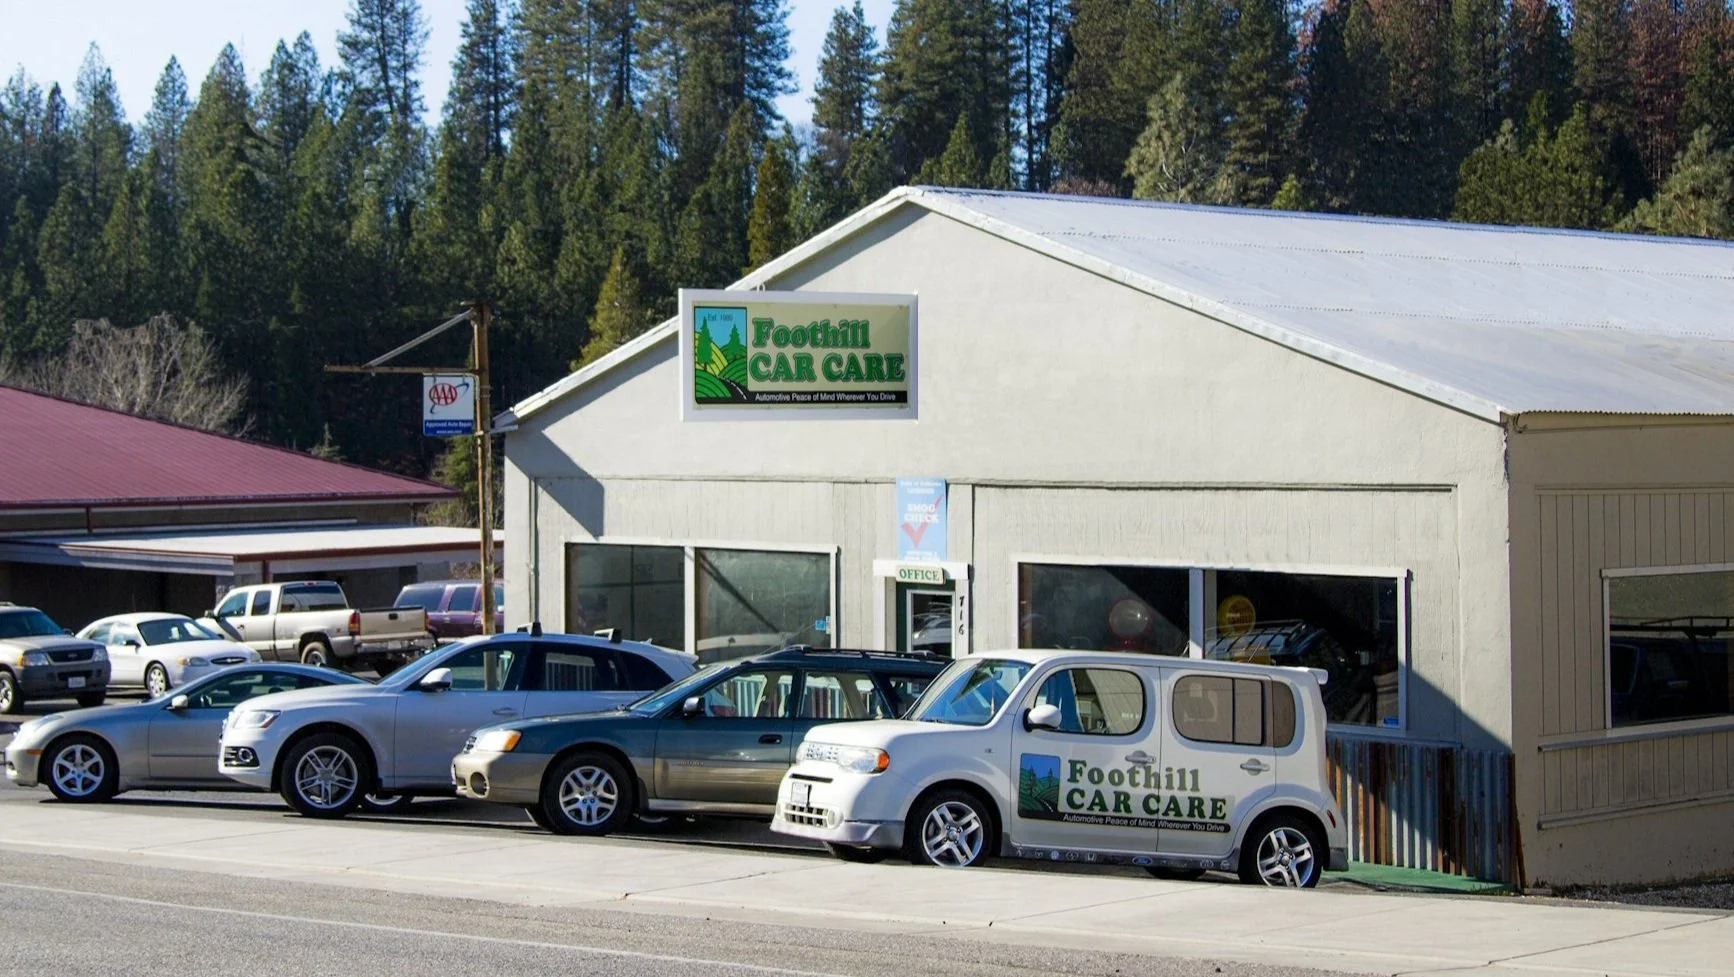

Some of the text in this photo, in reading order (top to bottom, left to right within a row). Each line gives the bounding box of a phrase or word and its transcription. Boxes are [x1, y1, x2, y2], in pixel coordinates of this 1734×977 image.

[752, 317, 871, 348] Foothill
[750, 352, 906, 382] CAR CARE
[431, 384, 456, 405] AAA
[755, 392, 896, 401] Automotive Peace of Mind Wherever You Drive
[904, 511, 940, 524] CHECK
[907, 503, 936, 513] SMOG
[899, 568, 940, 582] OFFICE
[1067, 759, 1200, 792] Foothill
[1066, 788, 1227, 820] CAR CARE
[1063, 814, 1104, 824] Automotive
[1105, 816, 1128, 825] Peace
[1138, 819, 1155, 828] Mind
[1157, 820, 1190, 830] Wherever
[1193, 822, 1205, 831] You
[1206, 823, 1225, 832] Drive
